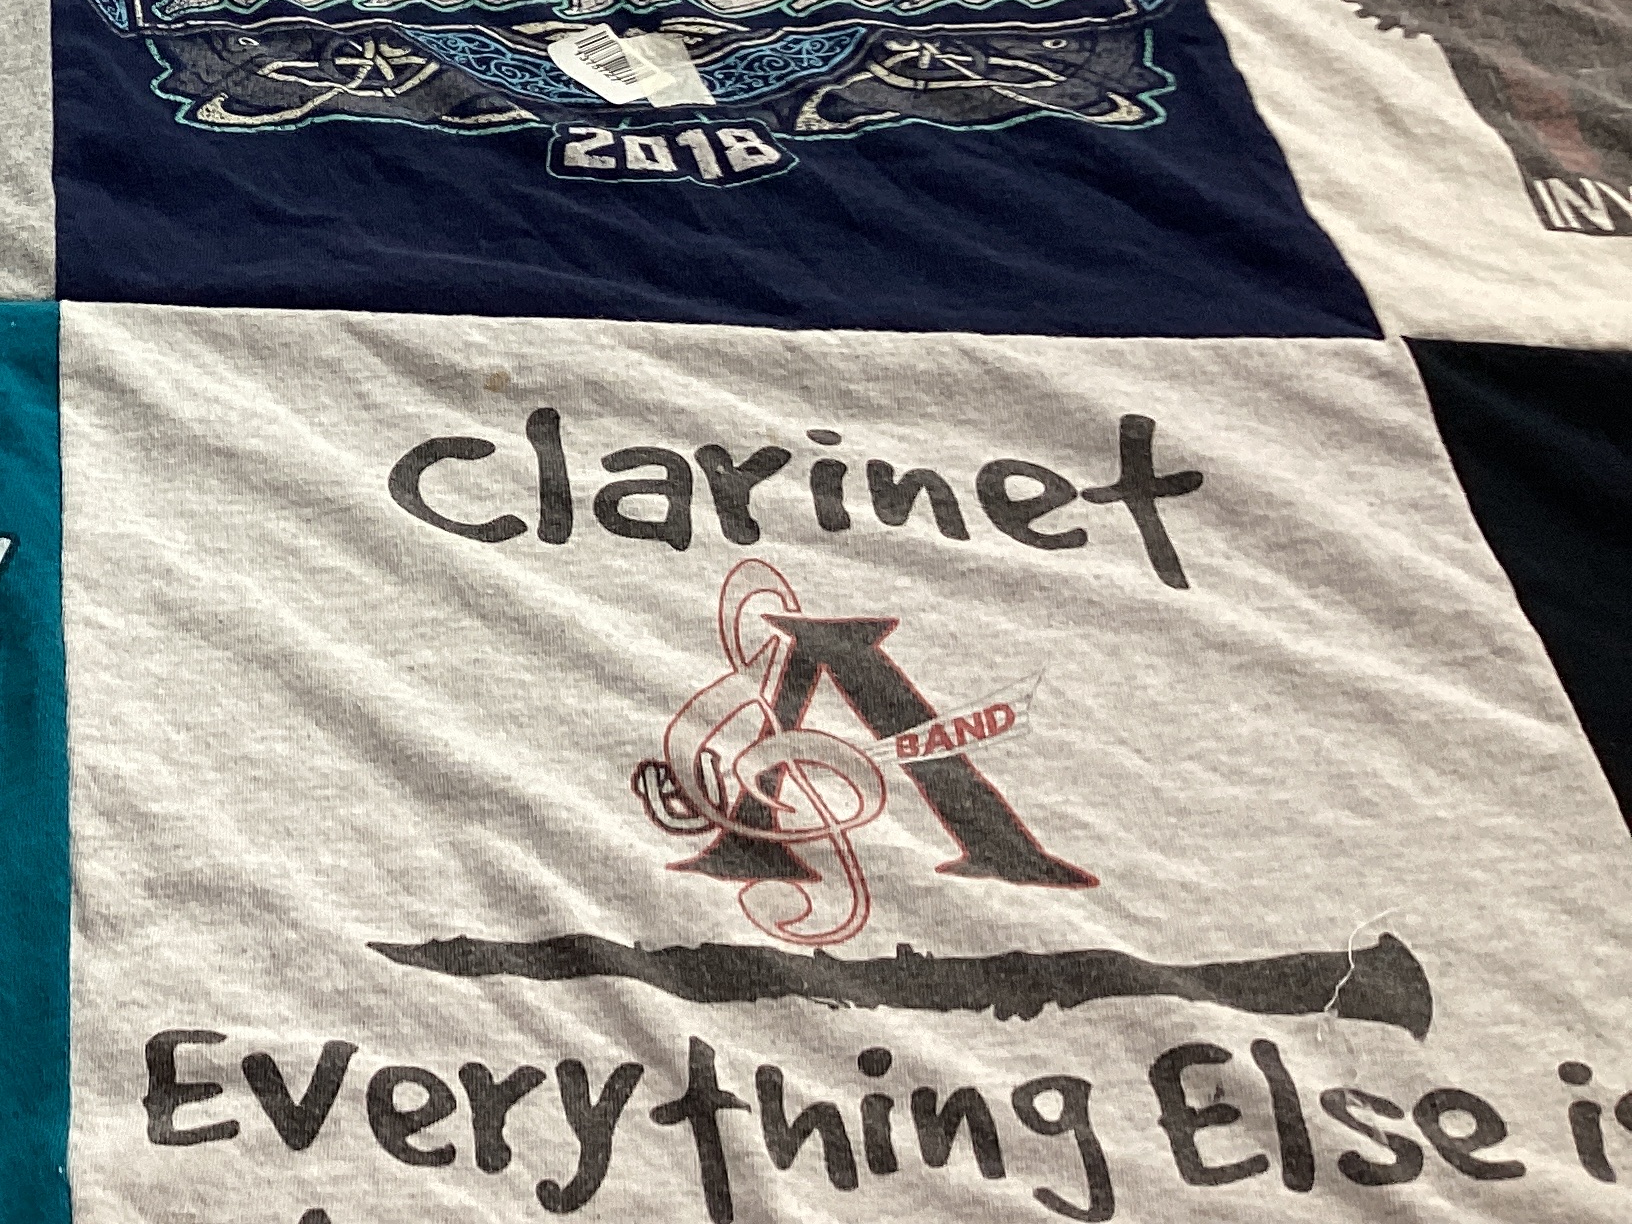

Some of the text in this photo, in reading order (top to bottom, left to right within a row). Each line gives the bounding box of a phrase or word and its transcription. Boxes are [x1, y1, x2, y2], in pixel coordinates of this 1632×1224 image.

[561, 122, 791, 183] 2018
[894, 701, 1018, 761] BAND
[143, 1029, 1118, 1224] Everything
[1149, 1039, 1526, 1191] Else
